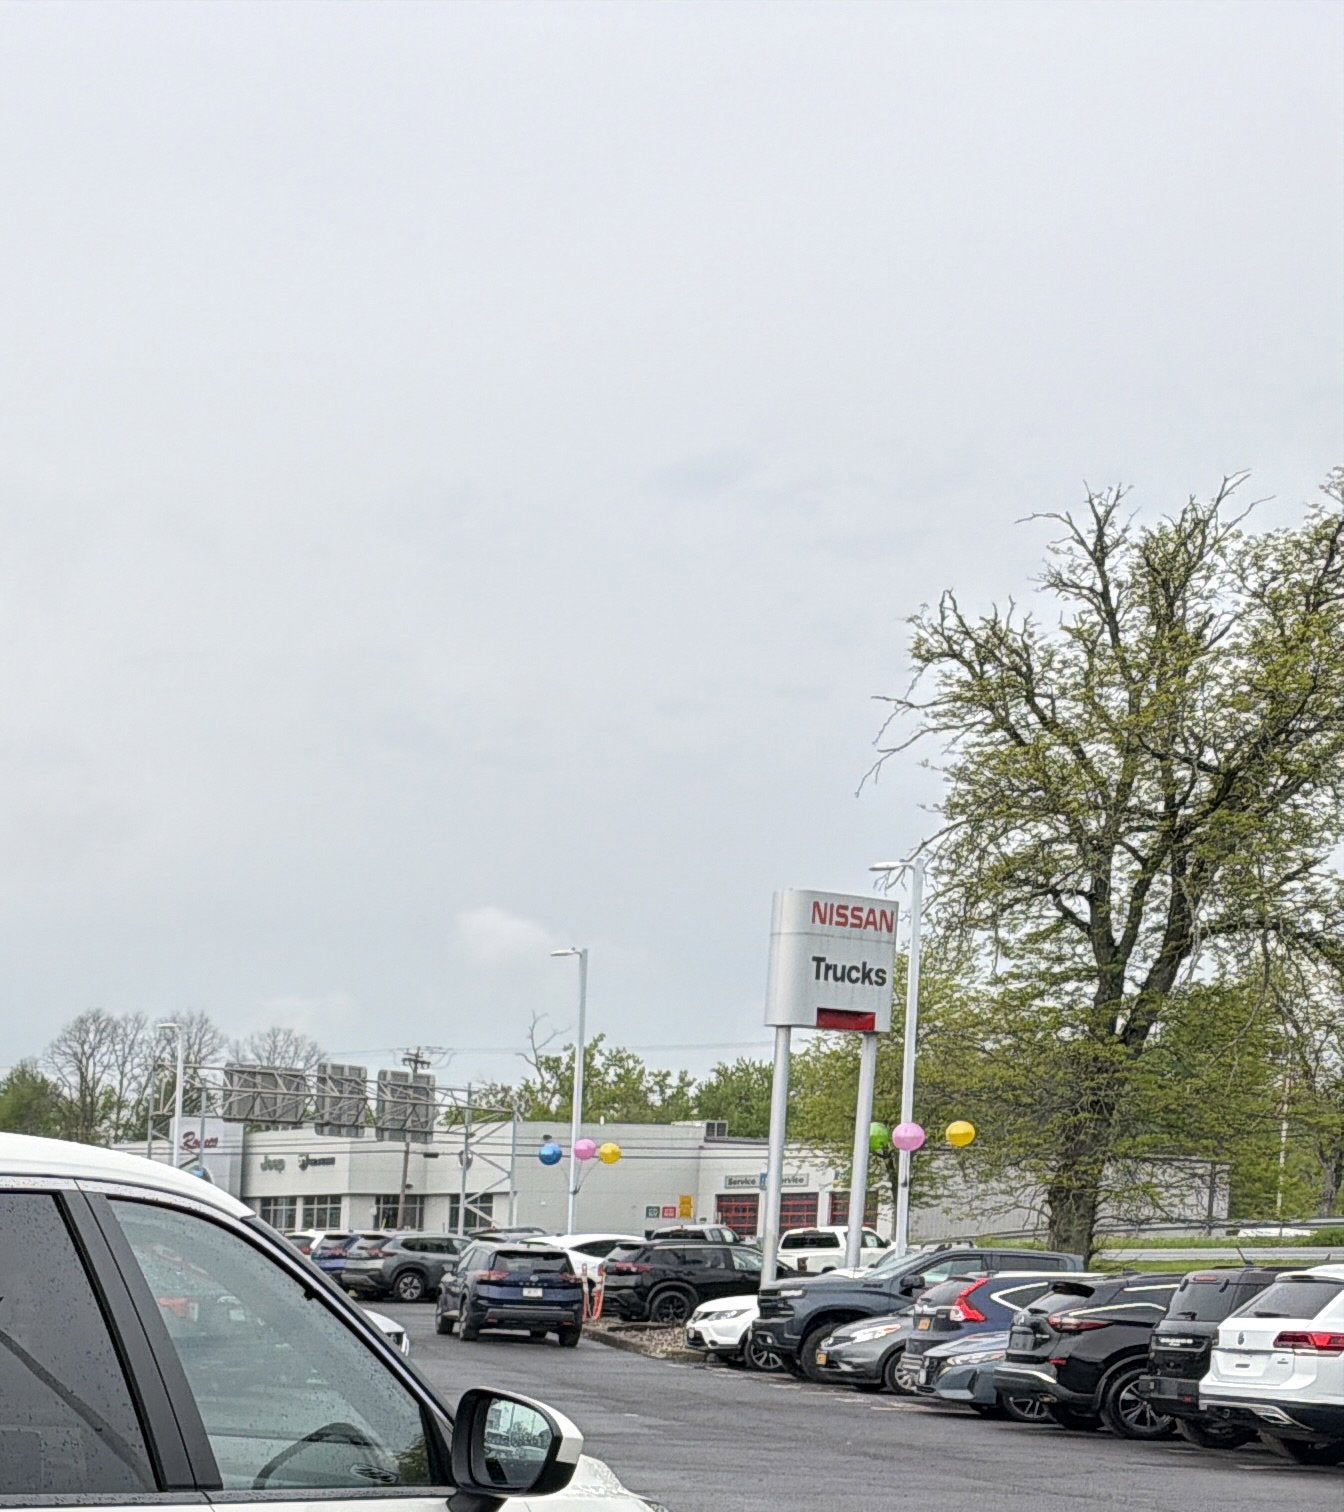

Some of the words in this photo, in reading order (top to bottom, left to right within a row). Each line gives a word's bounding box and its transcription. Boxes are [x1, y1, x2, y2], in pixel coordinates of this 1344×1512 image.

[812, 901, 895, 933] NISSAN
[812, 955, 887, 987] Trucks
[728, 1176, 757, 1186] Service
[782, 1174, 805, 1185] ervice
